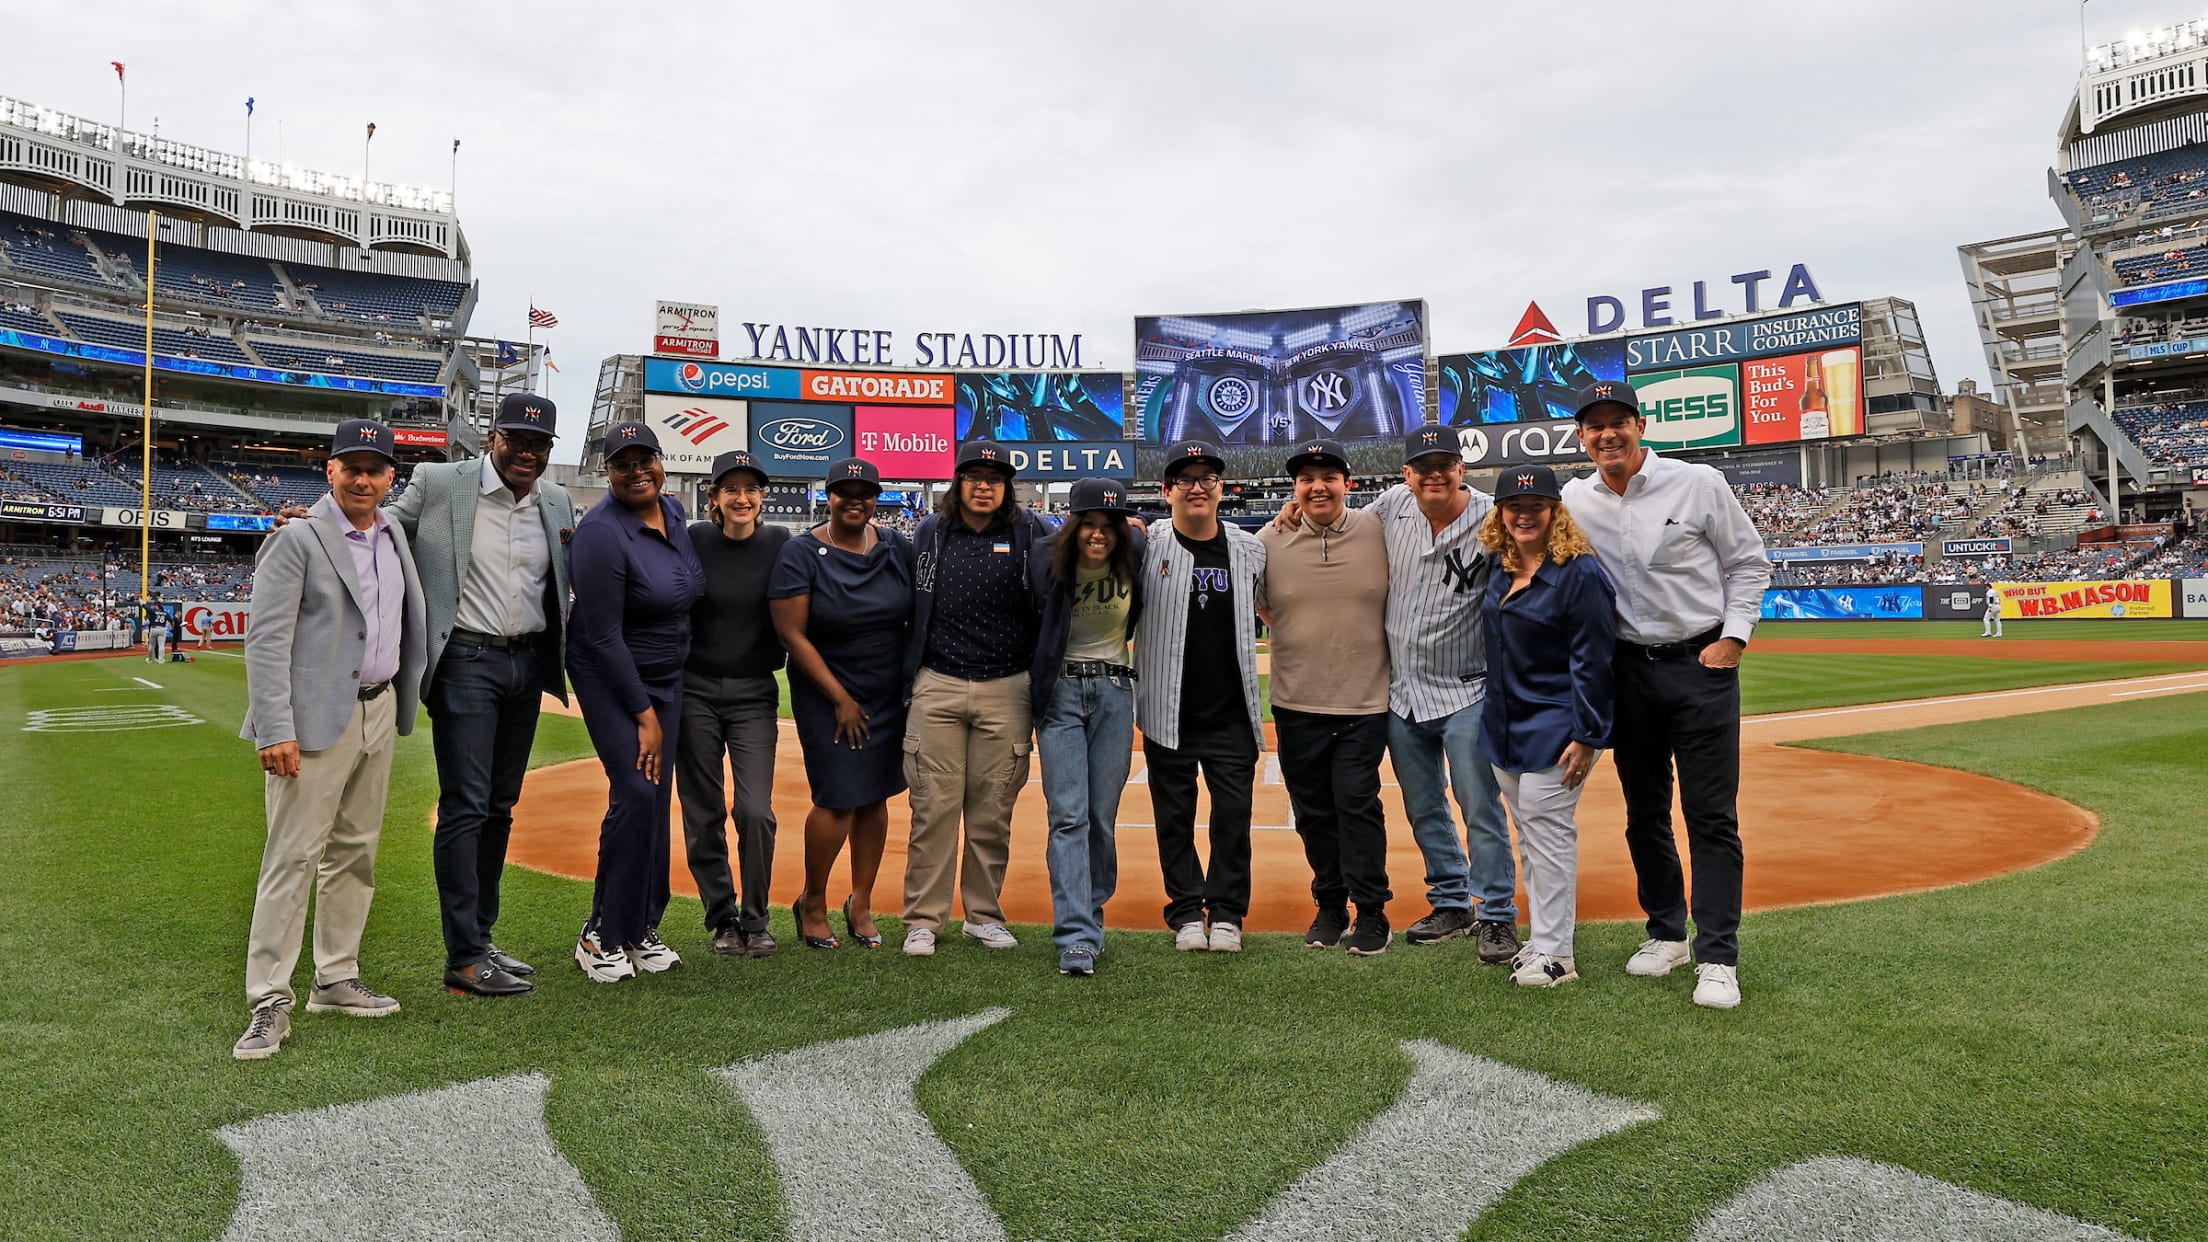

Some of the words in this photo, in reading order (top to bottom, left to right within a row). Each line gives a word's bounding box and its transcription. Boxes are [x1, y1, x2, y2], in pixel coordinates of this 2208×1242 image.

[1587, 263, 1824, 334] DELTA
[659, 305, 716, 319] ARMITRON
[1753, 308, 1859, 337] INSURANCE
[661, 338, 713, 349] ARMITRON
[1753, 322, 1860, 351] COMPANIES
[742, 323, 893, 365] YANKEE
[916, 332, 1082, 368] STADIUM
[1302, 344, 1329, 361] YORK
[1332, 339, 1376, 352] YANKEES
[1627, 329, 1740, 366] STARR
[2150, 345, 2166, 355] MLS
[2172, 342, 2188, 352] CUP
[1185, 349, 1224, 361] SEATTLE
[1748, 362, 1786, 379] This
[709, 372, 768, 392] pepsi
[812, 375, 944, 400] GATORADE
[1750, 377, 1794, 395] Bud's
[77, 401, 105, 412] Audi
[107, 404, 142, 416] YANKEES
[1640, 393, 1729, 423] HESS
[1750, 395, 1778, 409] For
[1270, 417, 1289, 429] VS
[1750, 409, 1786, 423] You.
[407, 434, 446, 444] Budweiser
[774, 421, 829, 448] Ford
[883, 433, 948, 453] Mobile
[1502, 424, 1586, 459] raz
[682, 454, 693, 462] OF
[774, 453, 829, 462] BuyFordNow.com
[1009, 449, 1124, 472] DELTA
[3, 505, 45, 515] ARMITRON
[48, 506, 65, 518] 6:51
[68, 508, 81, 519] PM
[1948, 542, 1997, 553] UNTUCKit
[1442, 548, 1485, 593] NY
[1189, 568, 1229, 592] YU
[2003, 588, 2025, 598] WHO
[2027, 586, 2047, 595] BUT
[2018, 583, 2151, 617] W.B.MASON
[155, 614, 165, 624] 28
[2111, 604, 2124, 617] hp
